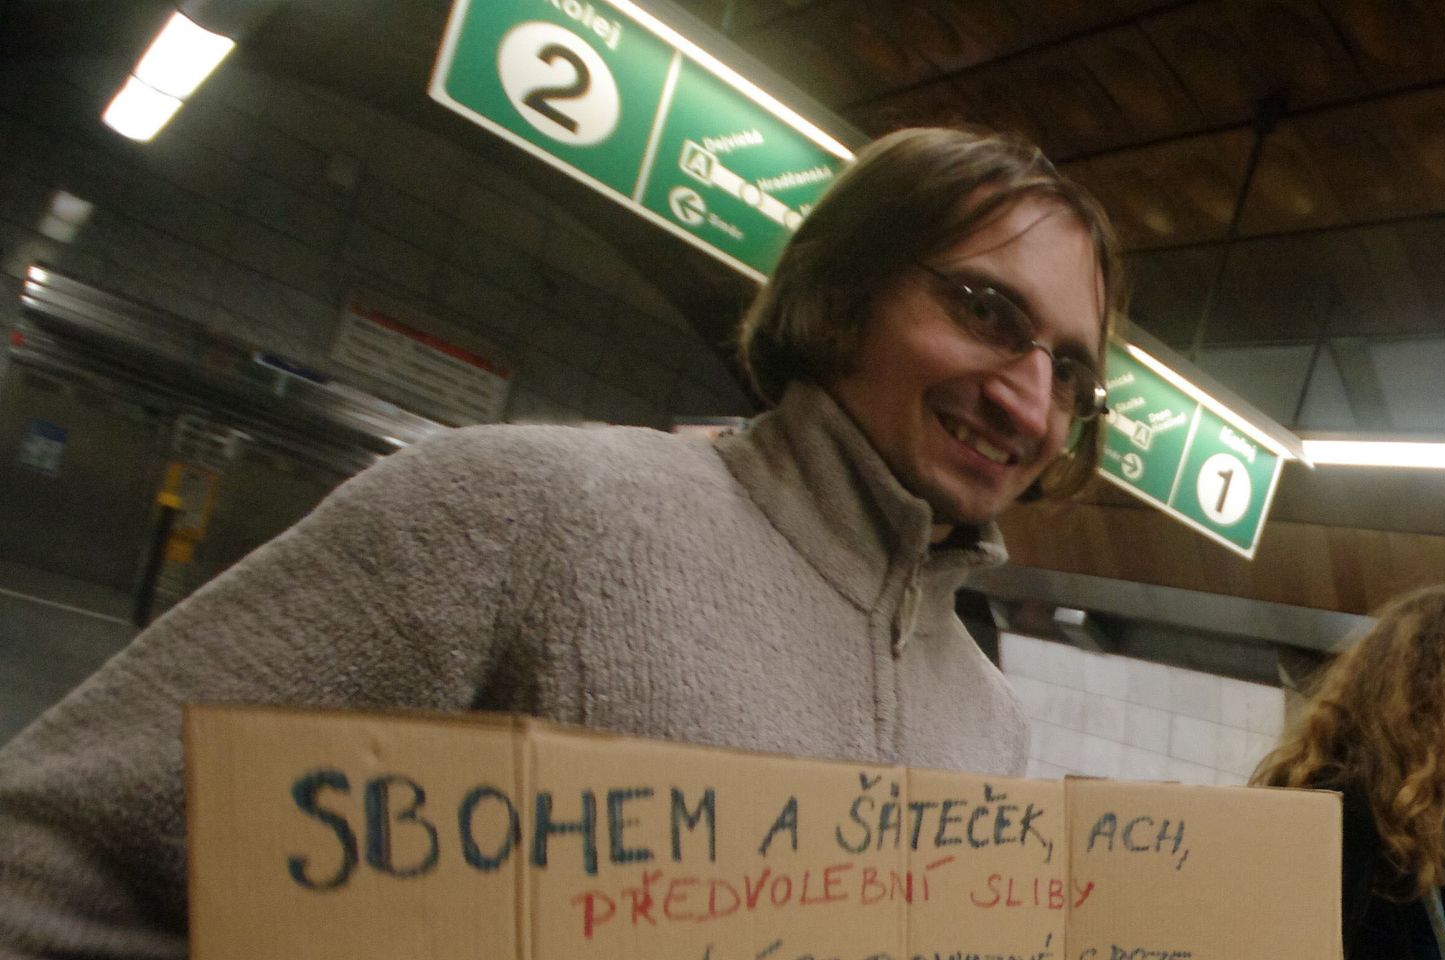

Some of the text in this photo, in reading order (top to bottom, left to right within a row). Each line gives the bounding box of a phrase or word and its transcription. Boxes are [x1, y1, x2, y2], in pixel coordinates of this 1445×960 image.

[523, 42, 591, 135] 2
[1217, 468, 1234, 514] 1
[287, 768, 717, 891] SBOHEM
[757, 797, 799, 856] A
[1087, 811, 1191, 870] ACH,
[571, 856, 1095, 940] PŘEDVOLEBNÍ SLIBY
